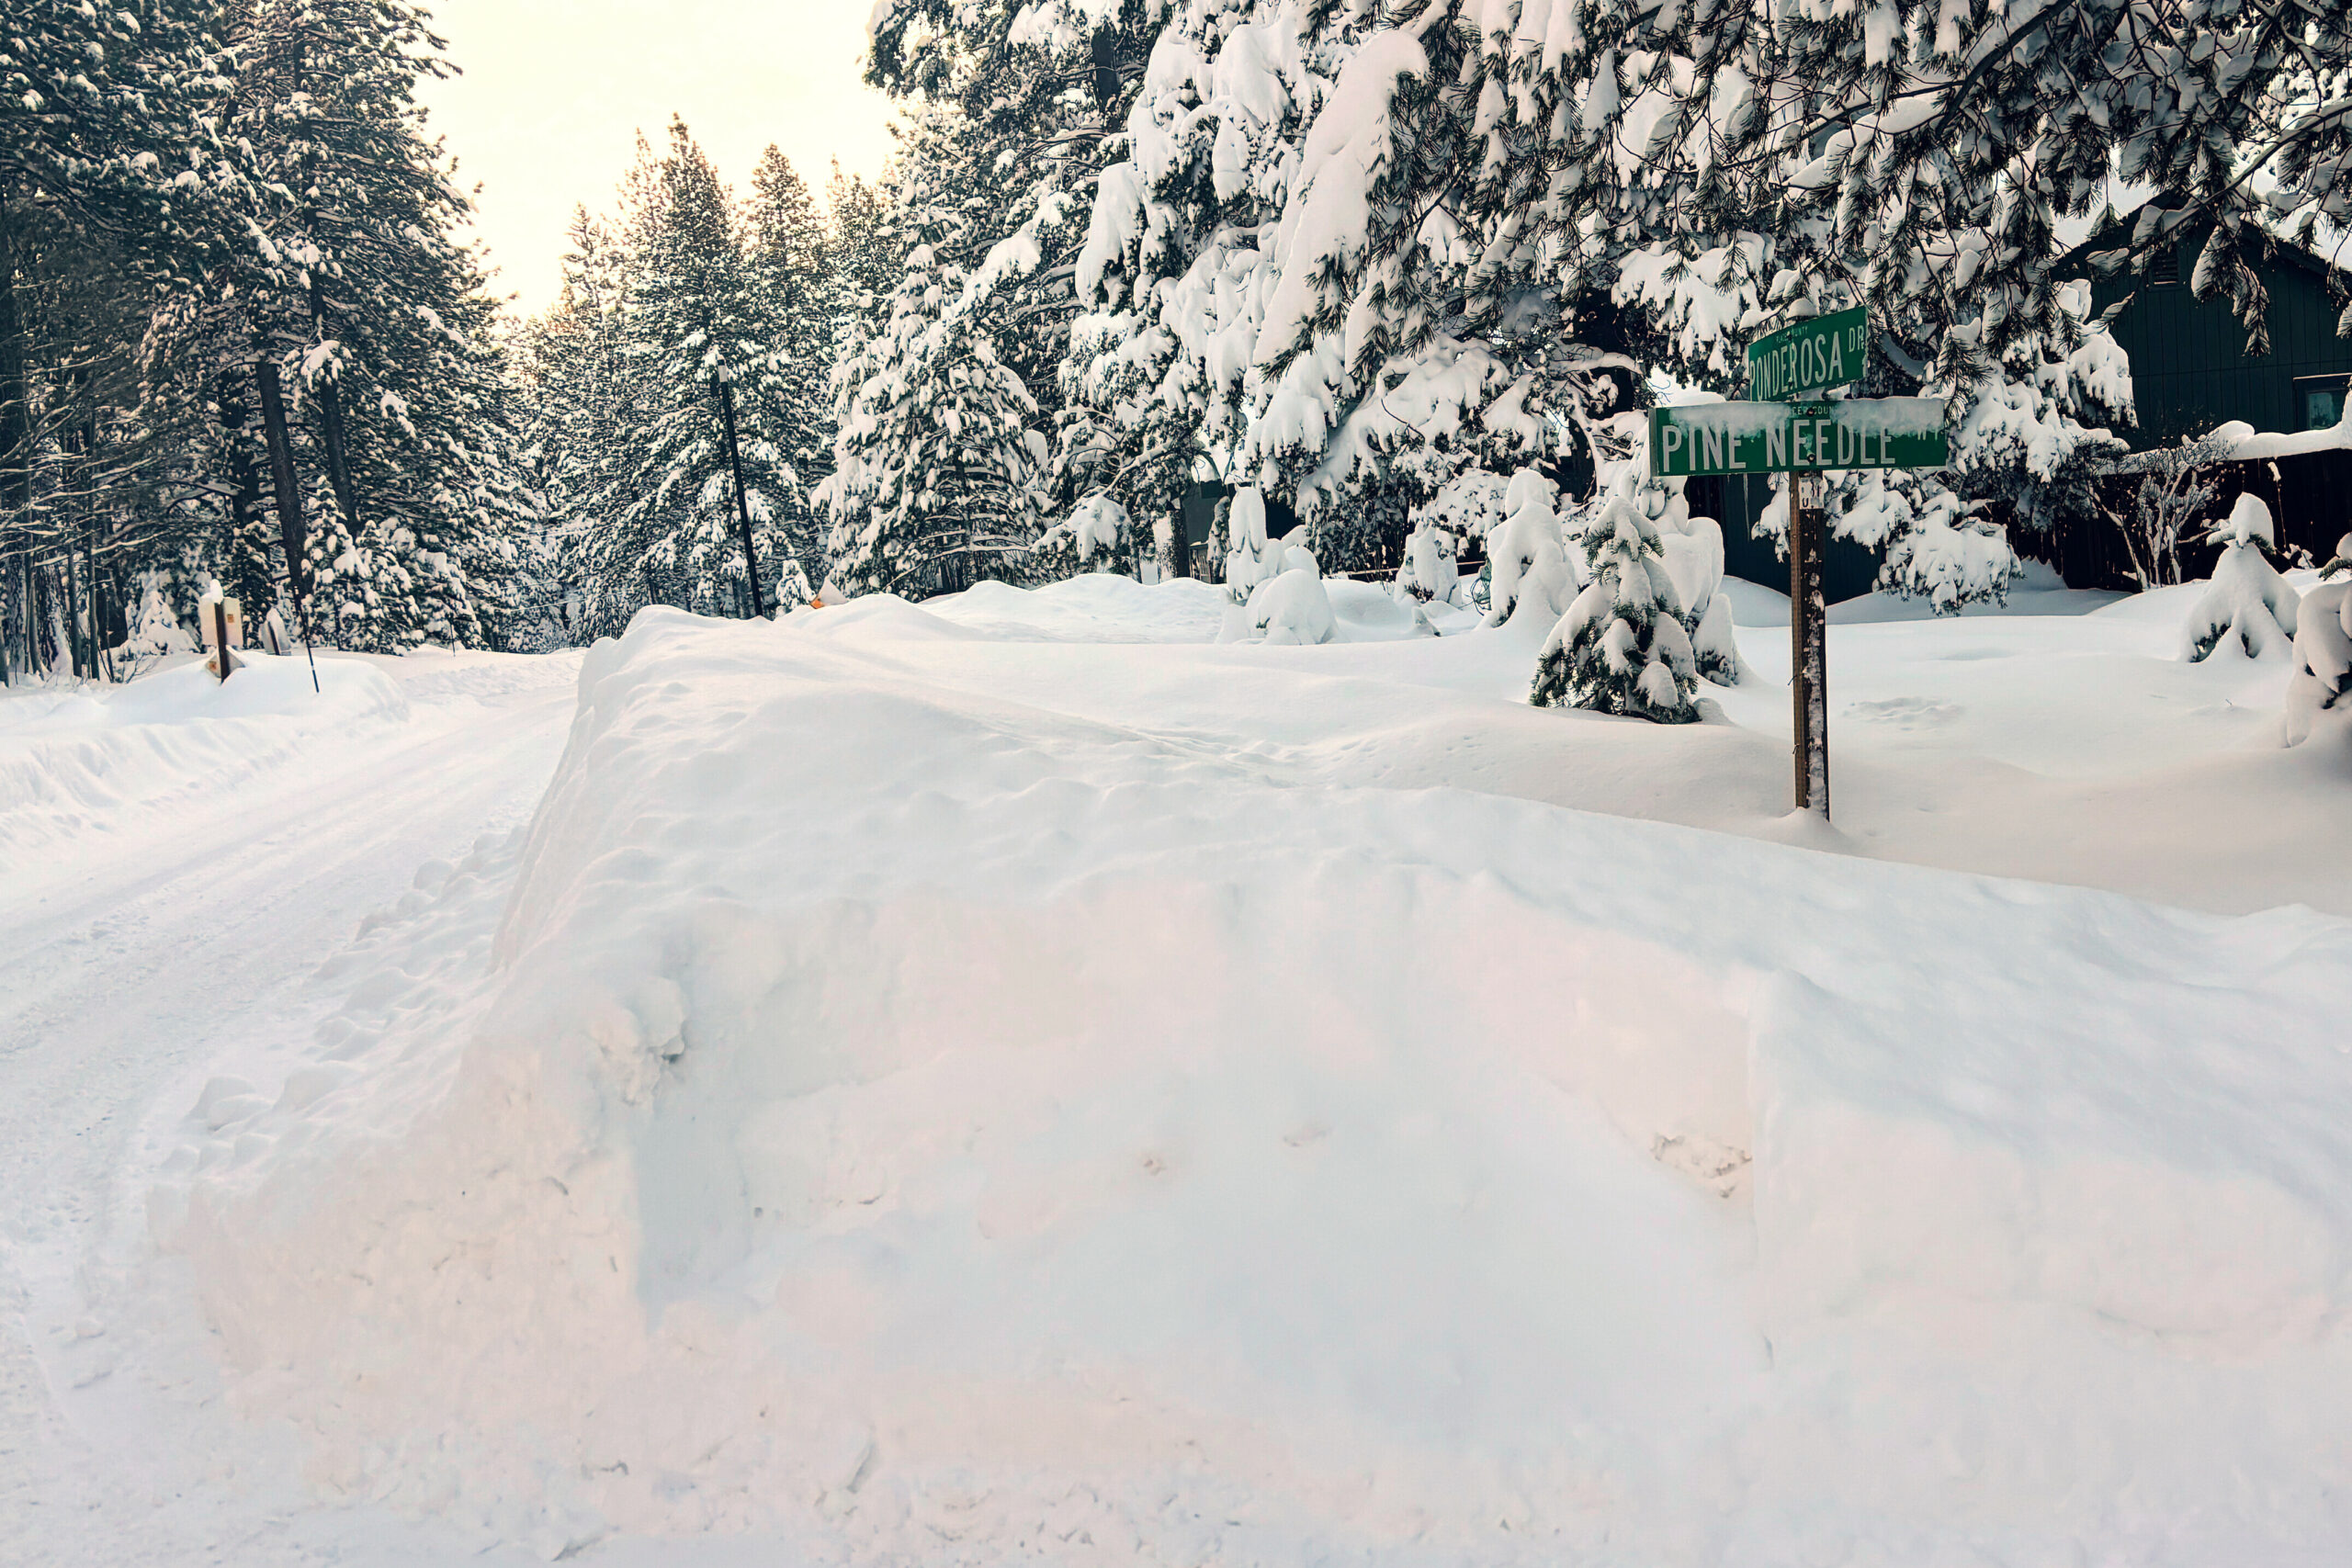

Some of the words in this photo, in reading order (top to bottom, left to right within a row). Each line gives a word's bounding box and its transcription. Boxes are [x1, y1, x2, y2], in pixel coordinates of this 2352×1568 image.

[1749, 331, 1844, 402] PONDEROSA
[1849, 325, 1865, 353] DR
[1662, 424, 1747, 473] PINE
[1766, 419, 1896, 468] NEEDLE
